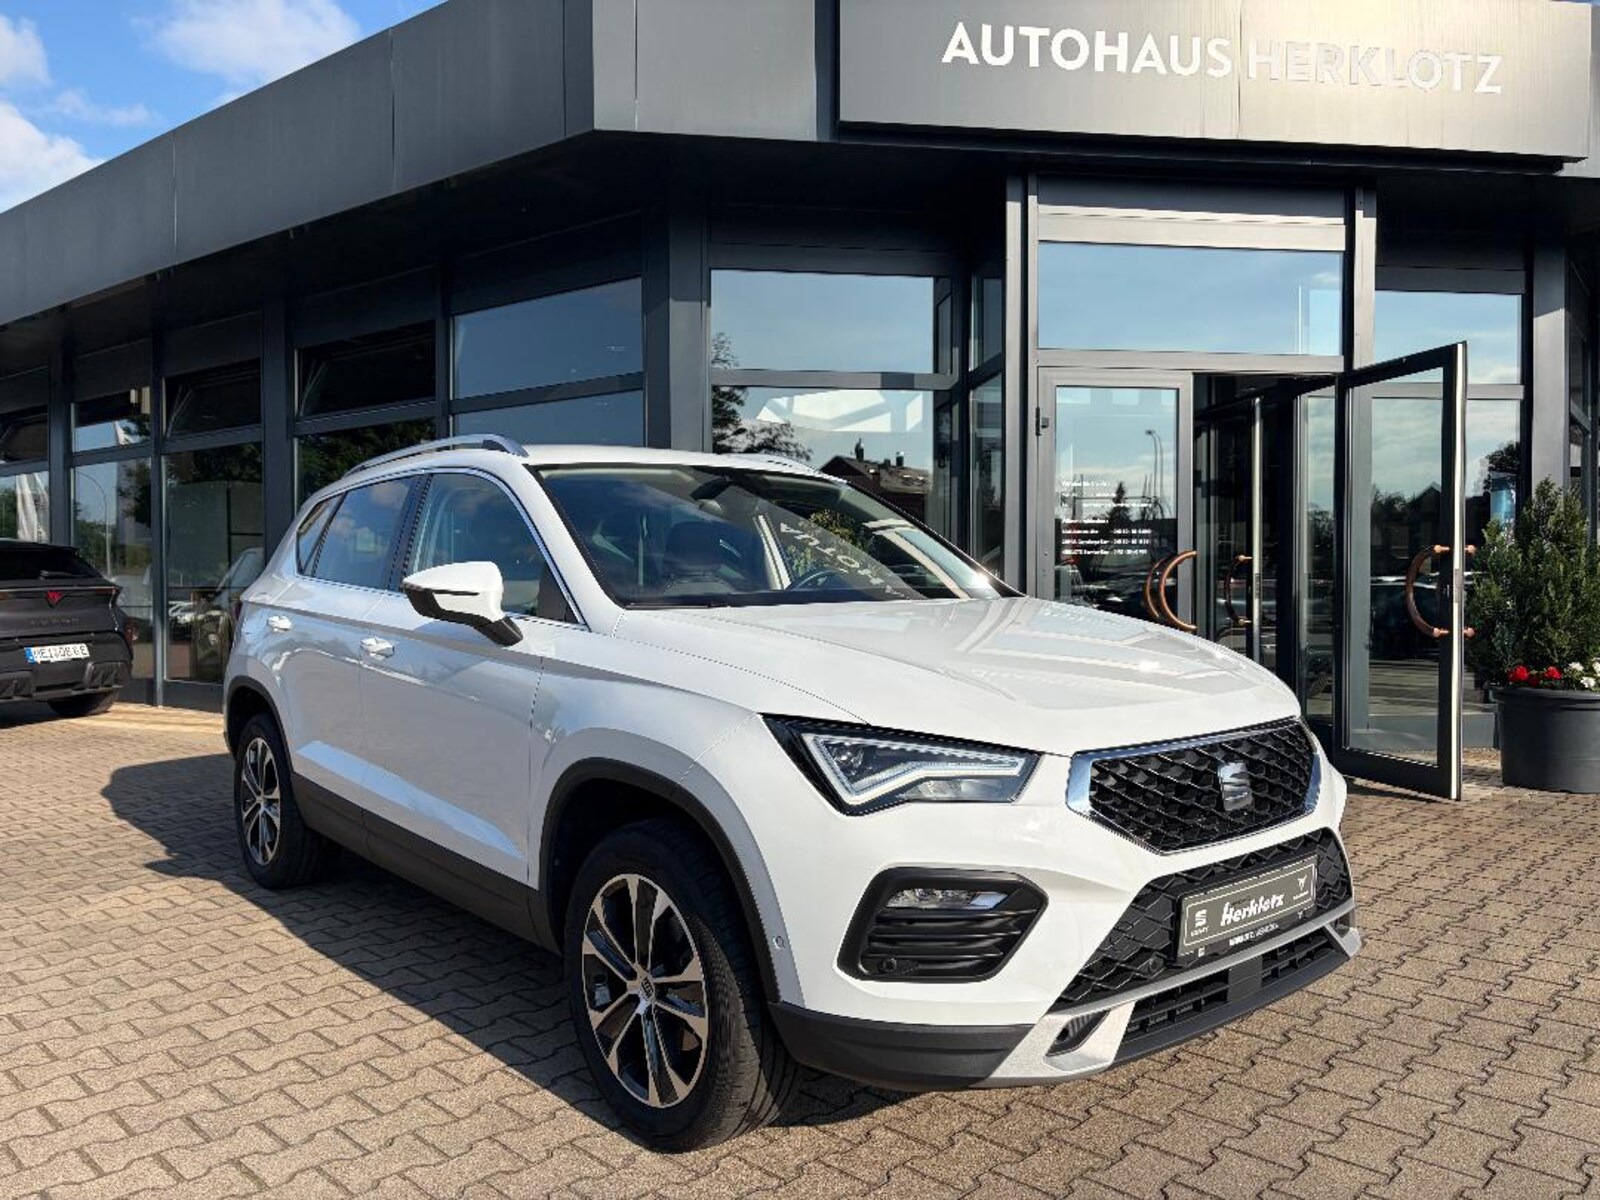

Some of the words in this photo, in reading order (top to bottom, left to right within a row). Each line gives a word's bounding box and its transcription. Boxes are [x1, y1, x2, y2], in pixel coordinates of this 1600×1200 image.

[942, 21, 1233, 78] AUTOHAUS
[1246, 38, 1503, 95] HERKLOTZ
[1220, 893, 1284, 926] Herklotz
